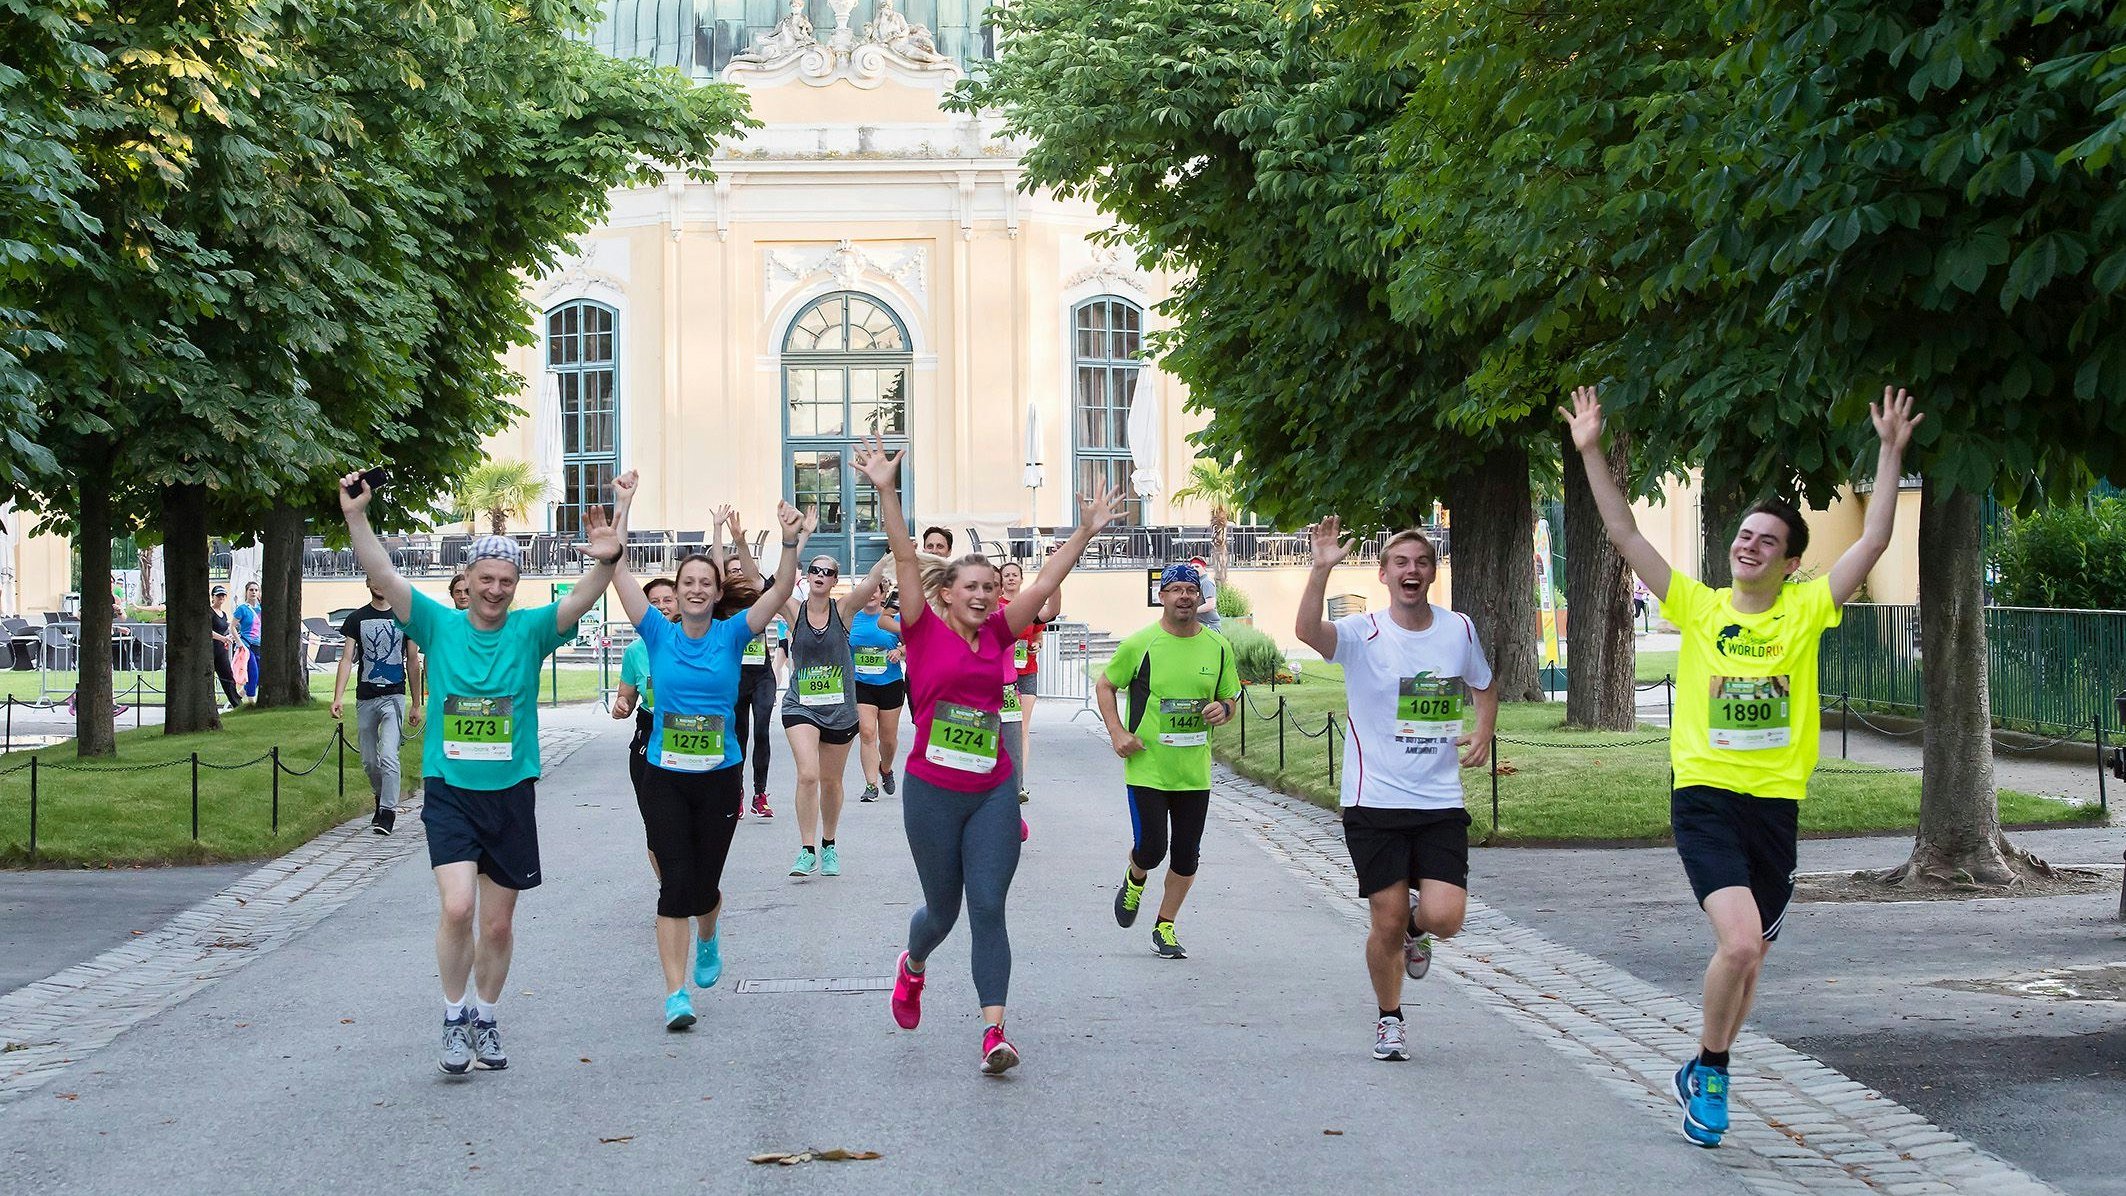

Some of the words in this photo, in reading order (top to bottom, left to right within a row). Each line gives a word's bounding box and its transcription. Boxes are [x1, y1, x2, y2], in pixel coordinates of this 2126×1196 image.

[810, 680, 830, 691] 894
[1410, 699, 1450, 715] 1078
[1722, 702, 1771, 721] 1890
[454, 719, 496, 736] 1273
[1169, 716, 1200, 728] 1447
[672, 733, 710, 749] 1275
[943, 726, 985, 748] 1274
